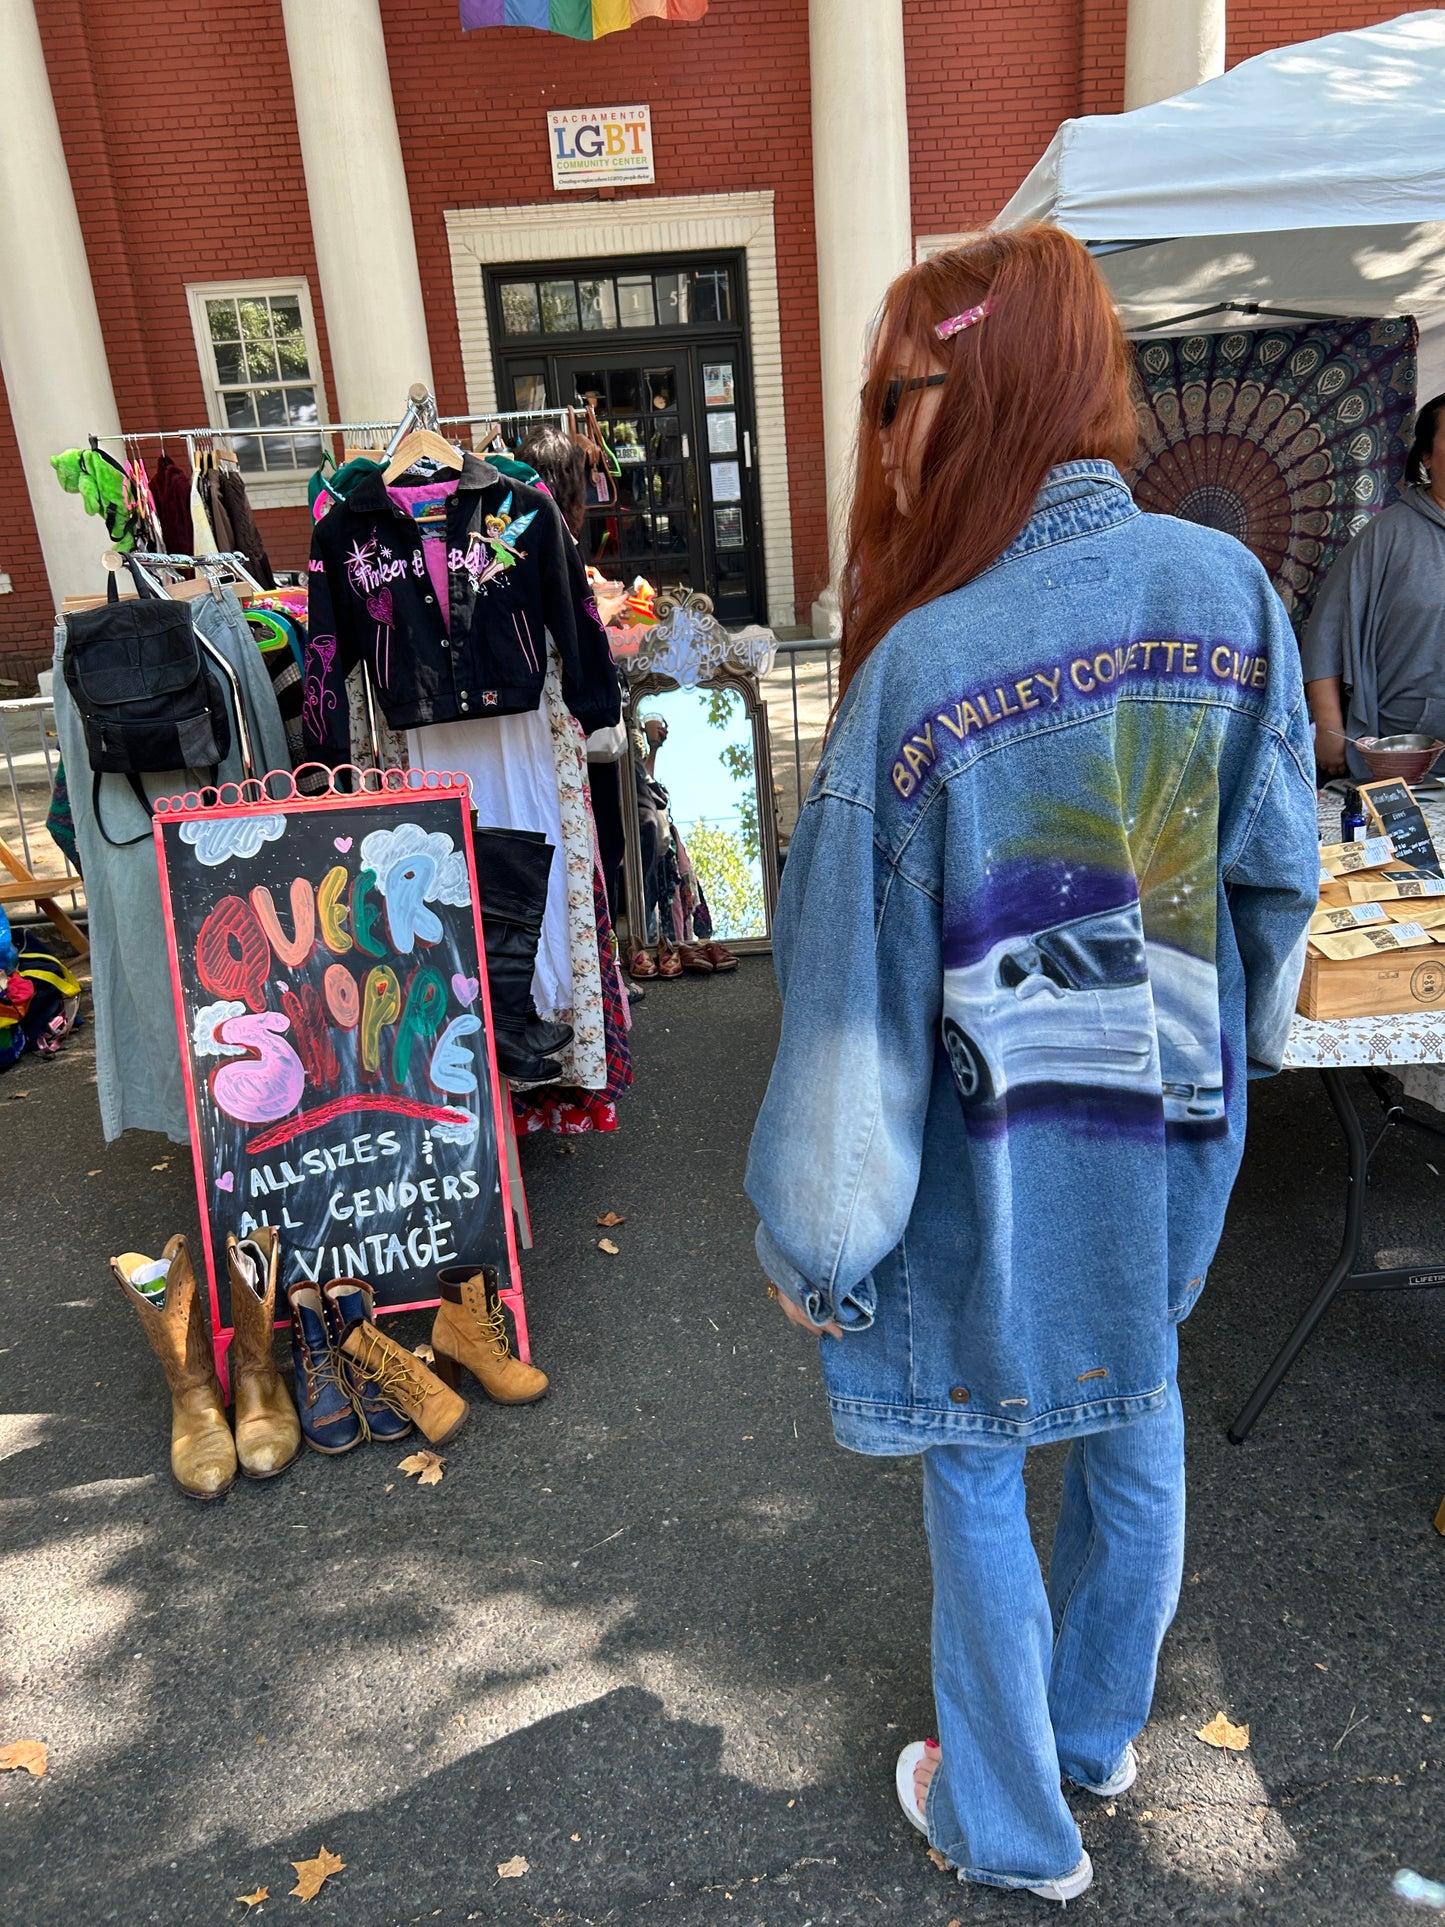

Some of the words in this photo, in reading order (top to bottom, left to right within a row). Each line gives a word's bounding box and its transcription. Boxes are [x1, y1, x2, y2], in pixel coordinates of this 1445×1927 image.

[552, 111, 645, 124] SACRAMENTO
[554, 122, 646, 159] LGBT
[556, 159, 610, 169] COMMUNITY
[612, 156, 648, 166] CENTER
[892, 722, 936, 797] BAY
[937, 667, 1060, 740] VALLEY
[1211, 645, 1268, 690] CLUB
[196, 854, 444, 1012] QUEER
[209, 963, 482, 1123] SHOPPE
[250, 1161, 305, 1198] ALL
[302, 1130, 401, 1175] SIZES
[240, 1207, 304, 1239] ALL
[329, 1170, 480, 1221] GENDERS
[294, 1221, 458, 1283] VINTAGE
